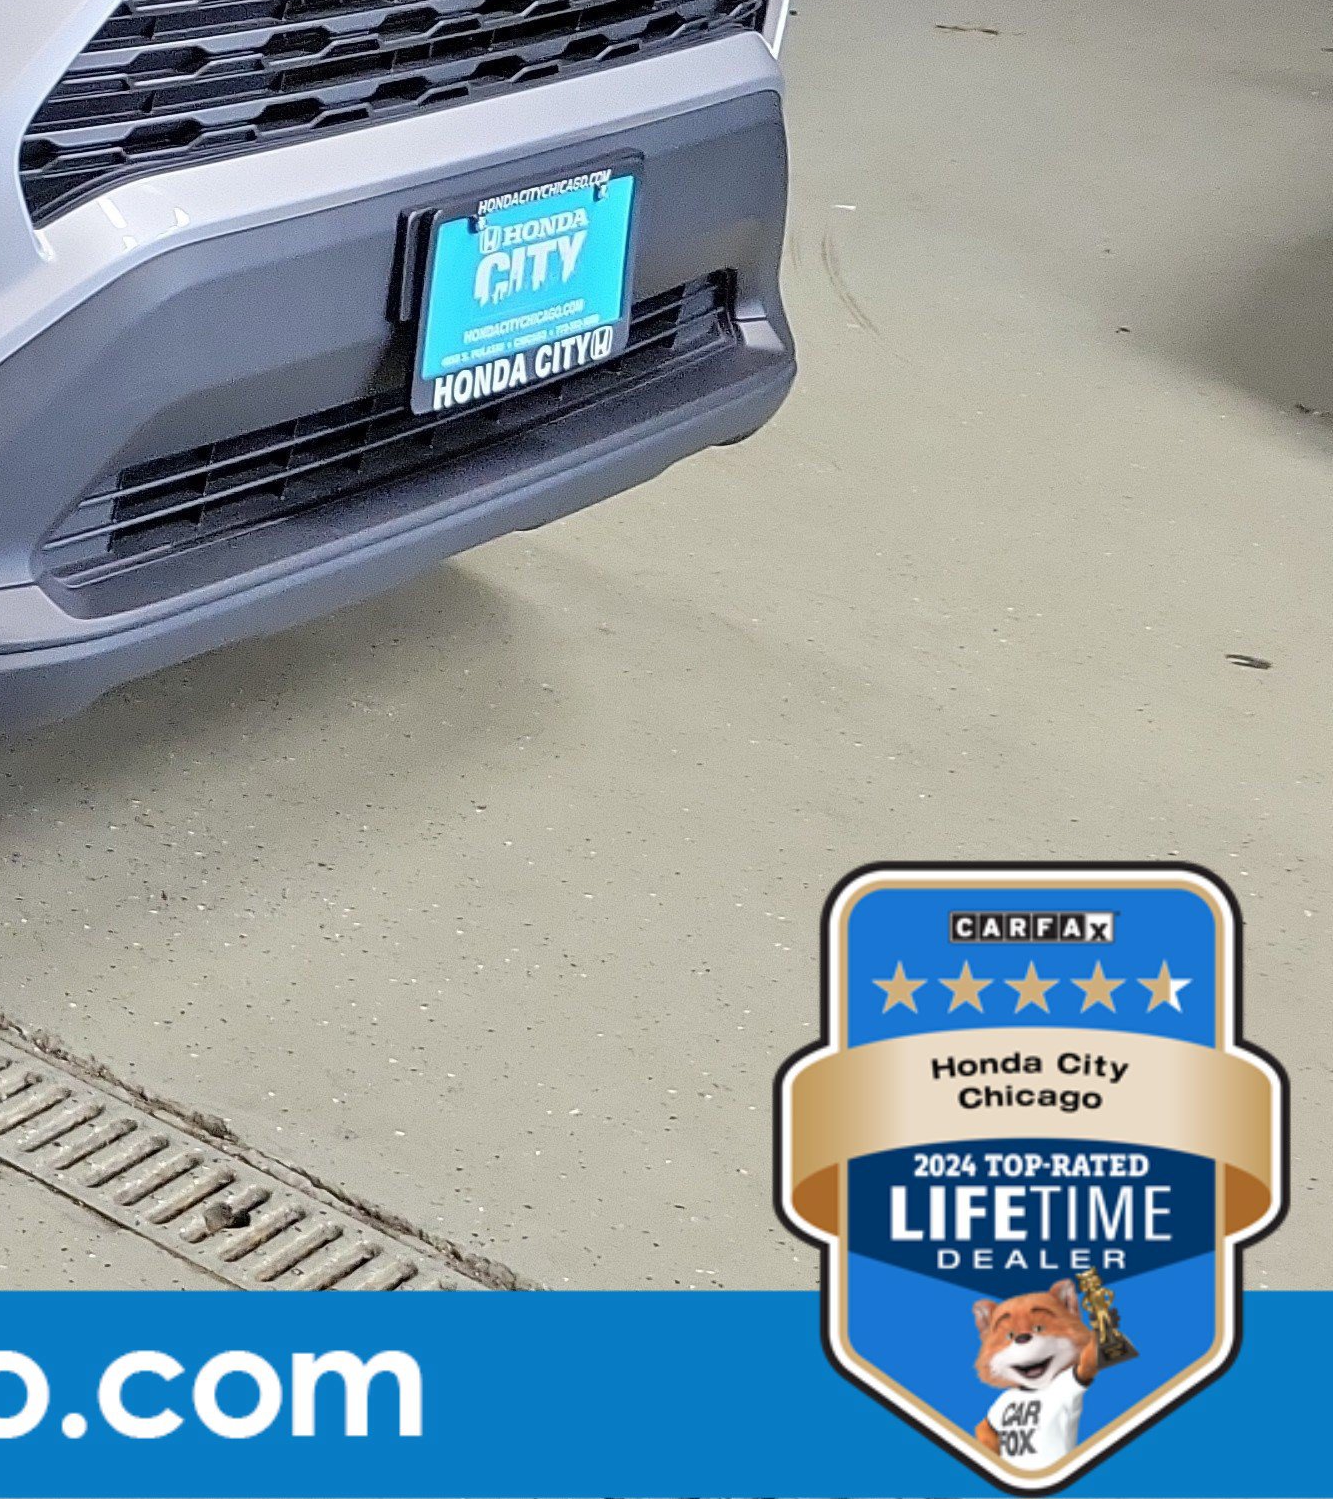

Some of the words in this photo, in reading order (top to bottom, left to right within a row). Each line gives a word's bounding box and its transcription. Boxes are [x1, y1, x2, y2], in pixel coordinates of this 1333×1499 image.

[501, 207, 589, 247] HONDA
[473, 230, 588, 307] CITY
[432, 353, 528, 411] HONDA
[534, 331, 593, 380] CITY
